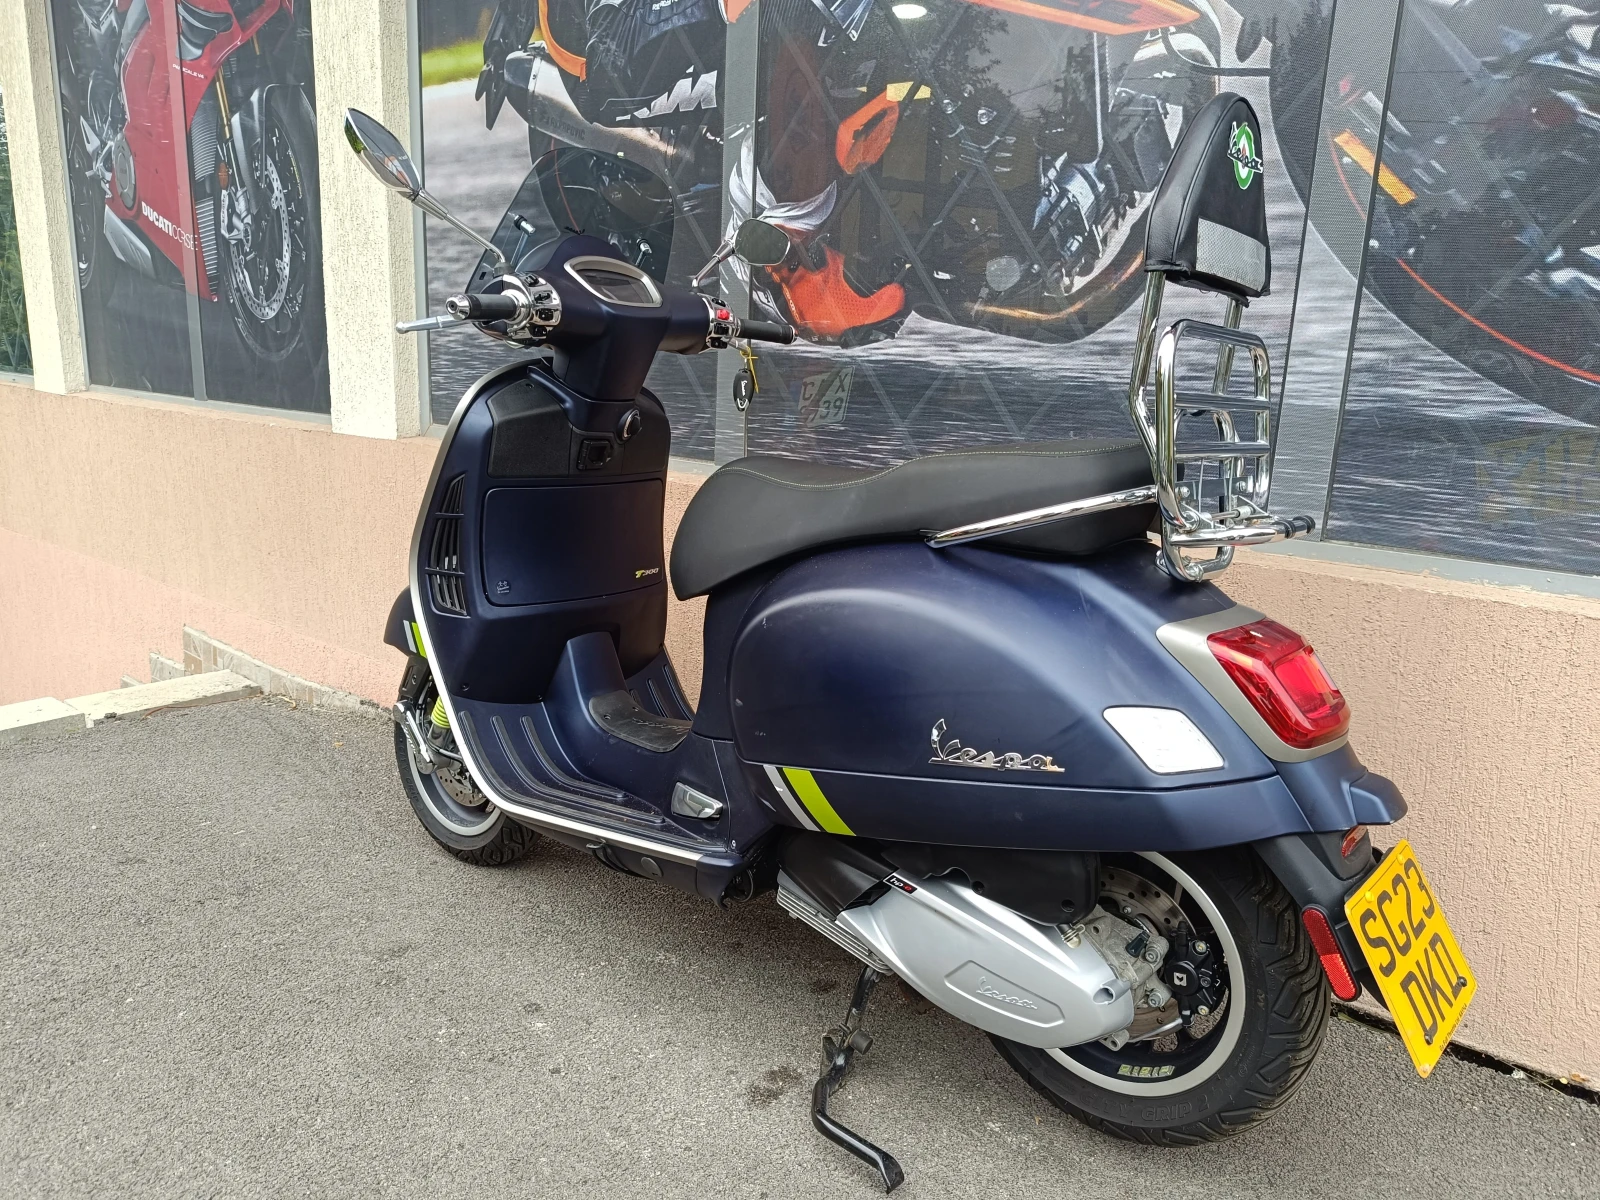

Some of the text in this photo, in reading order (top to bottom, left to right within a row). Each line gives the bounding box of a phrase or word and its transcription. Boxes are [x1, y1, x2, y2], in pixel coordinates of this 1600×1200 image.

[1227, 121, 1264, 173] Vespa
[928, 718, 1065, 773] Vespa
[1359, 858, 1435, 978] SG23
[976, 976, 1038, 1011] Vespa
[1400, 932, 1464, 1043] DKD
[1141, 1102, 1193, 1122] GRIP
